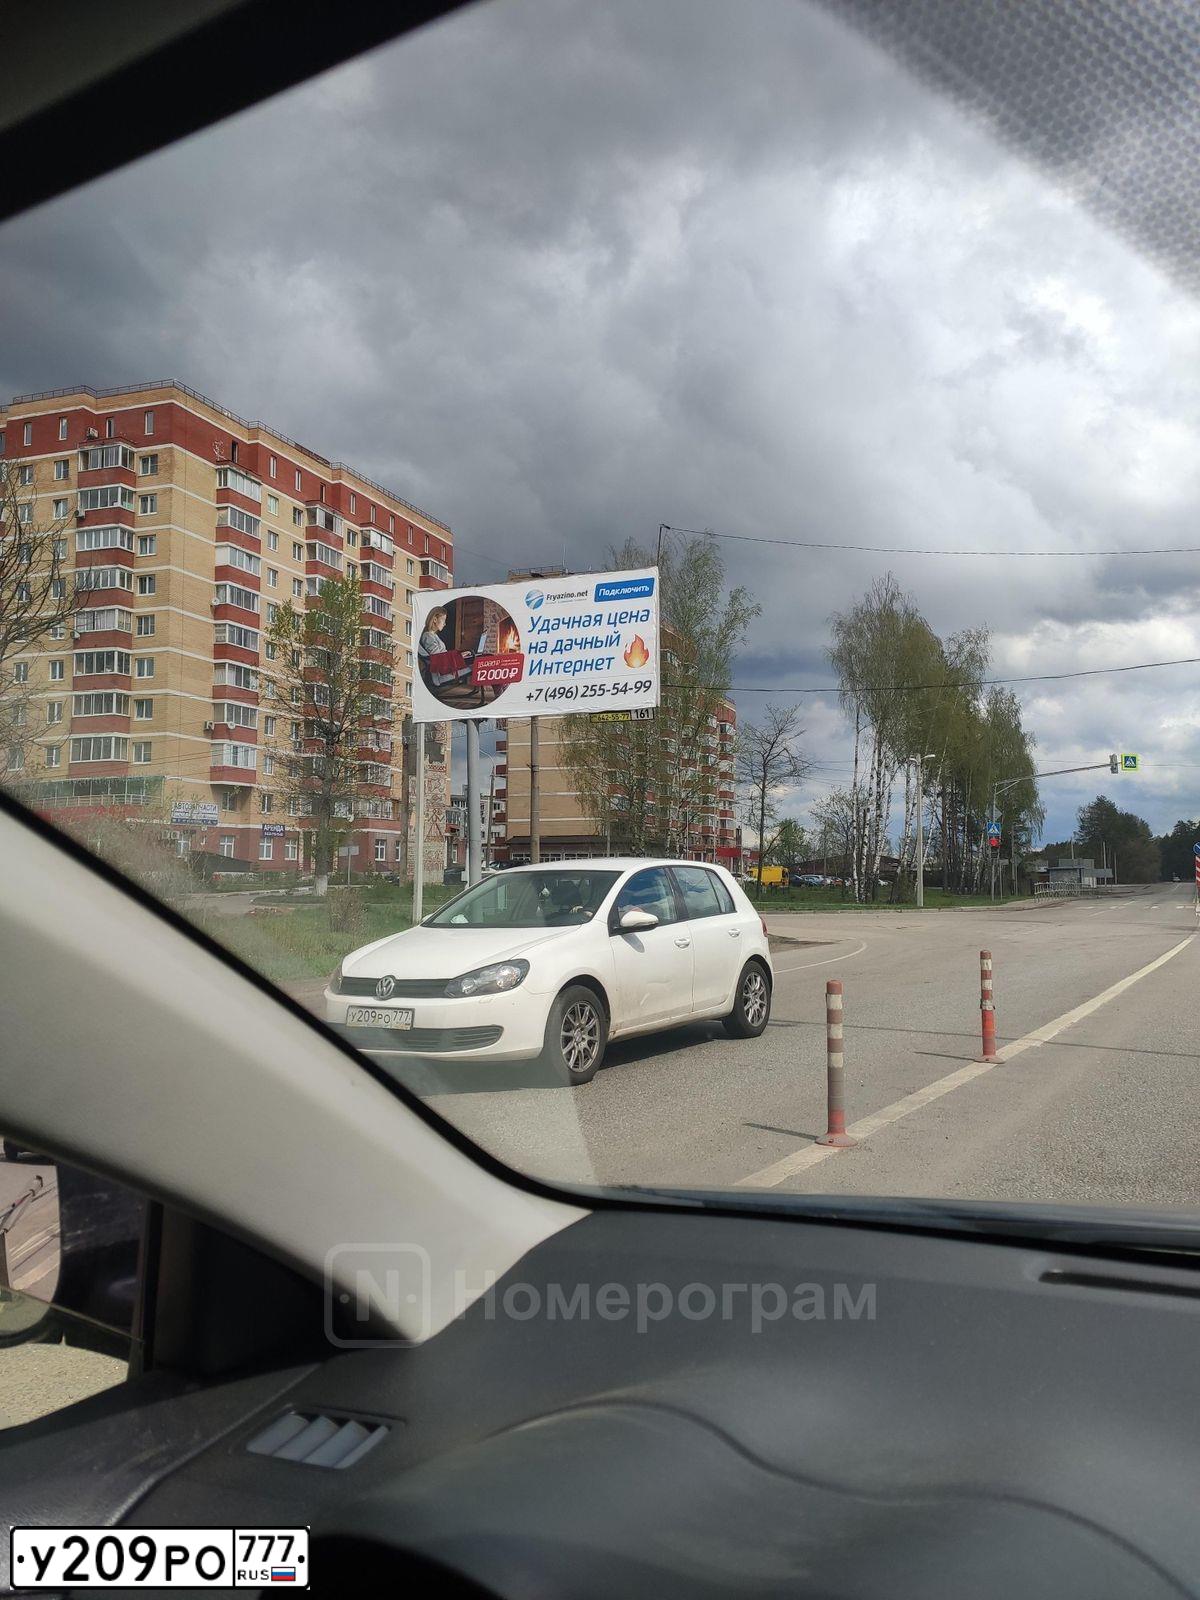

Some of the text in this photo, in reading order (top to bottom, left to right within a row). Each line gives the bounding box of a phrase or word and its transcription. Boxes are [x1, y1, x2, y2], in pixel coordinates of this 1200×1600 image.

[546, 590, 588, 601] Fryazino.net
[598, 584, 650, 597] Подключить
[528, 609, 650, 635] Удачная цена
[528, 631, 621, 656] на дачный
[528, 656, 615, 677] Интернет
[526, 680, 652, 703] +7 (496) 255-54-99
[634, 708, 650, 719] 161
